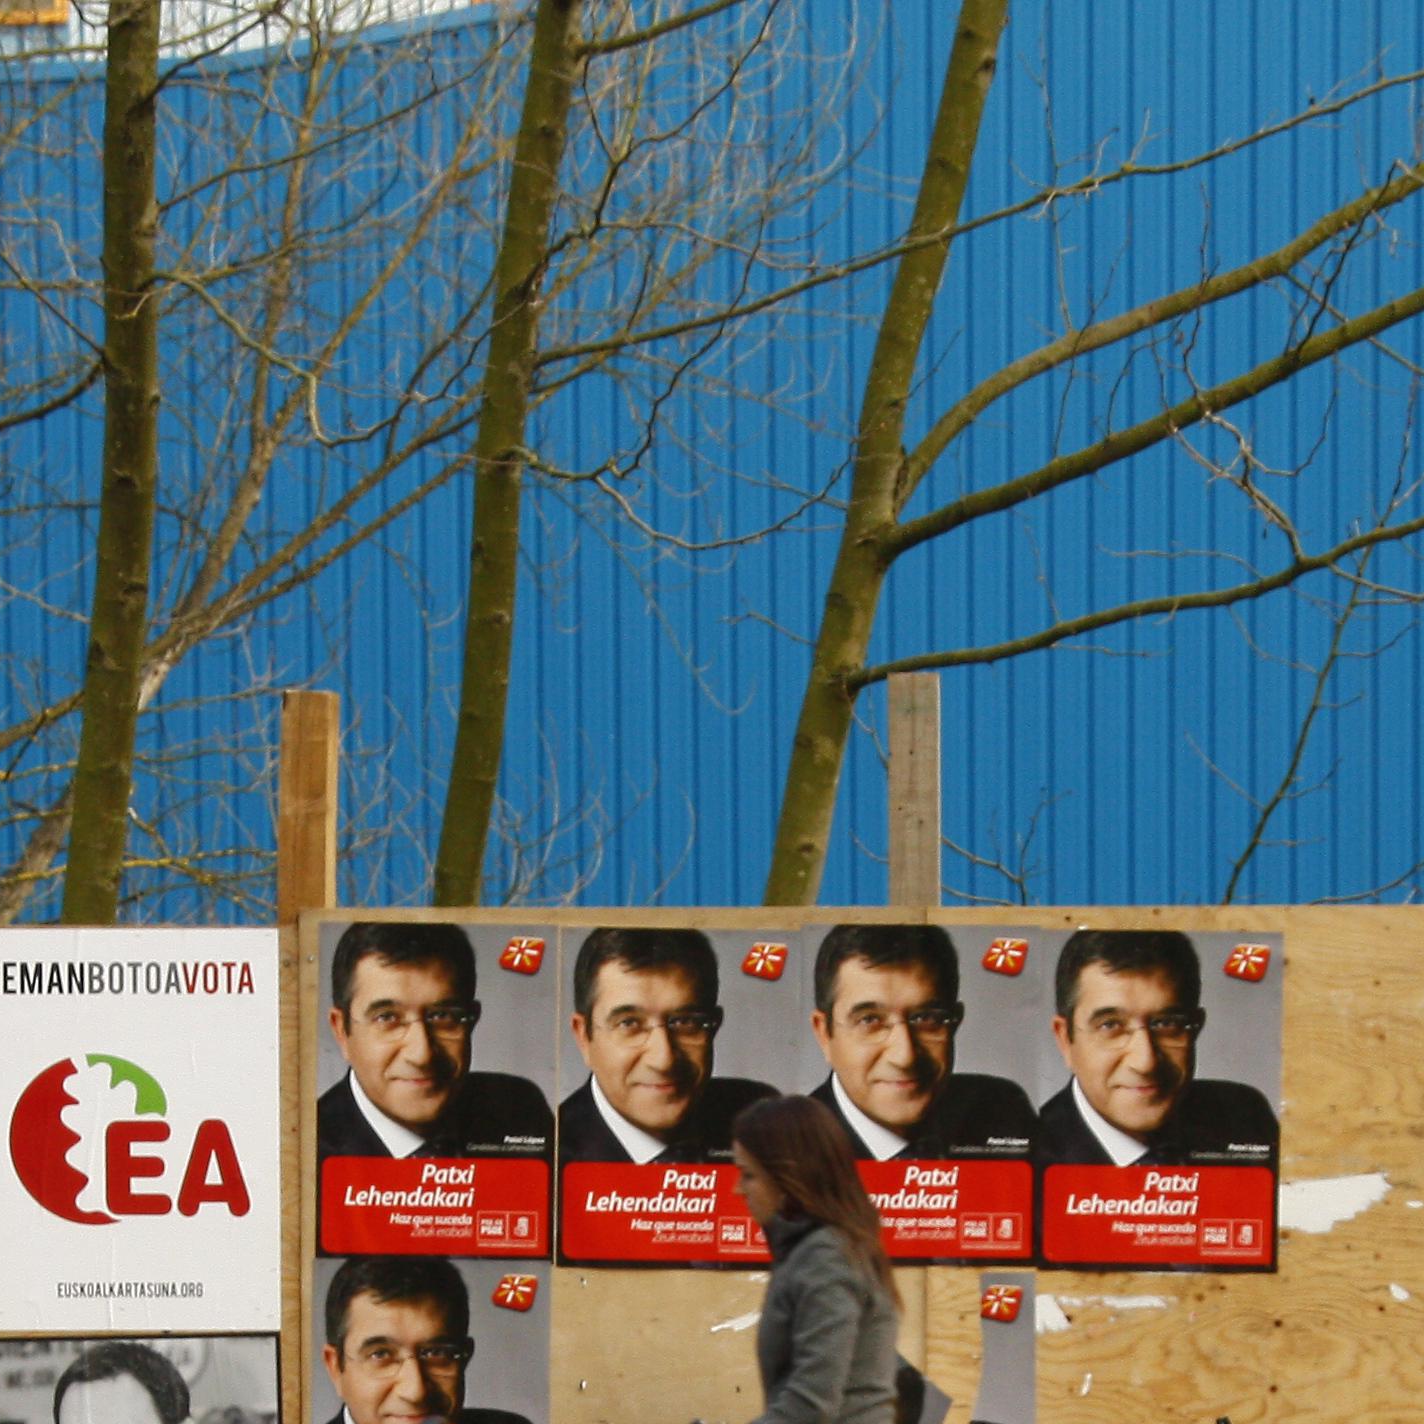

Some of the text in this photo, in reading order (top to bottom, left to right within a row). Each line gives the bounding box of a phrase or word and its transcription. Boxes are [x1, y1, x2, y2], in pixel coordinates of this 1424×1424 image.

[105, 1117, 251, 1218] EA
[421, 1163, 476, 1185] Patxi
[904, 1165, 960, 1188] Patxi
[662, 1169, 718, 1191] Patxi
[1144, 1170, 1200, 1193] Patxi
[344, 1185, 475, 1208] Lehendakari
[585, 1191, 718, 1213] Lehendakari
[868, 1187, 960, 1210] endakari
[1065, 1193, 1200, 1216] Lehendakari
[389, 1212, 413, 1226] Haz
[413, 1215, 434, 1230] que
[434, 1213, 473, 1226] suceda
[630, 1218, 653, 1231] Haz
[654, 1220, 676, 1234] que
[56, 1281, 204, 1300] EUSKOALKARTASUNA.ORG
